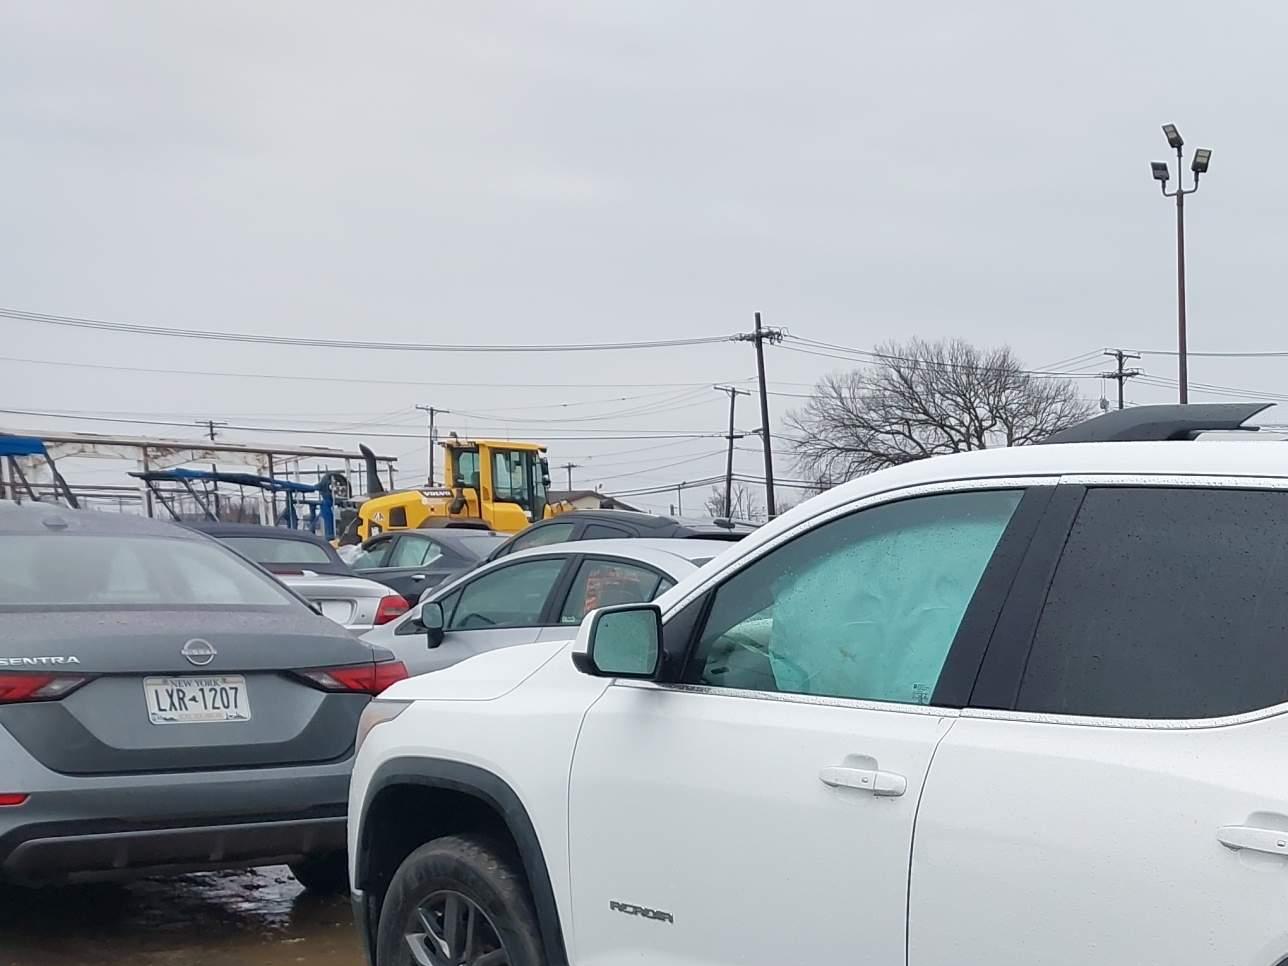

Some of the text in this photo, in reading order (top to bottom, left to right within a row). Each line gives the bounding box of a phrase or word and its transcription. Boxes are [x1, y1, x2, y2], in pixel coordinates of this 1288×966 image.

[170, 679, 222, 688] NEW YORK
[609, 900, 674, 924] ACADIA
